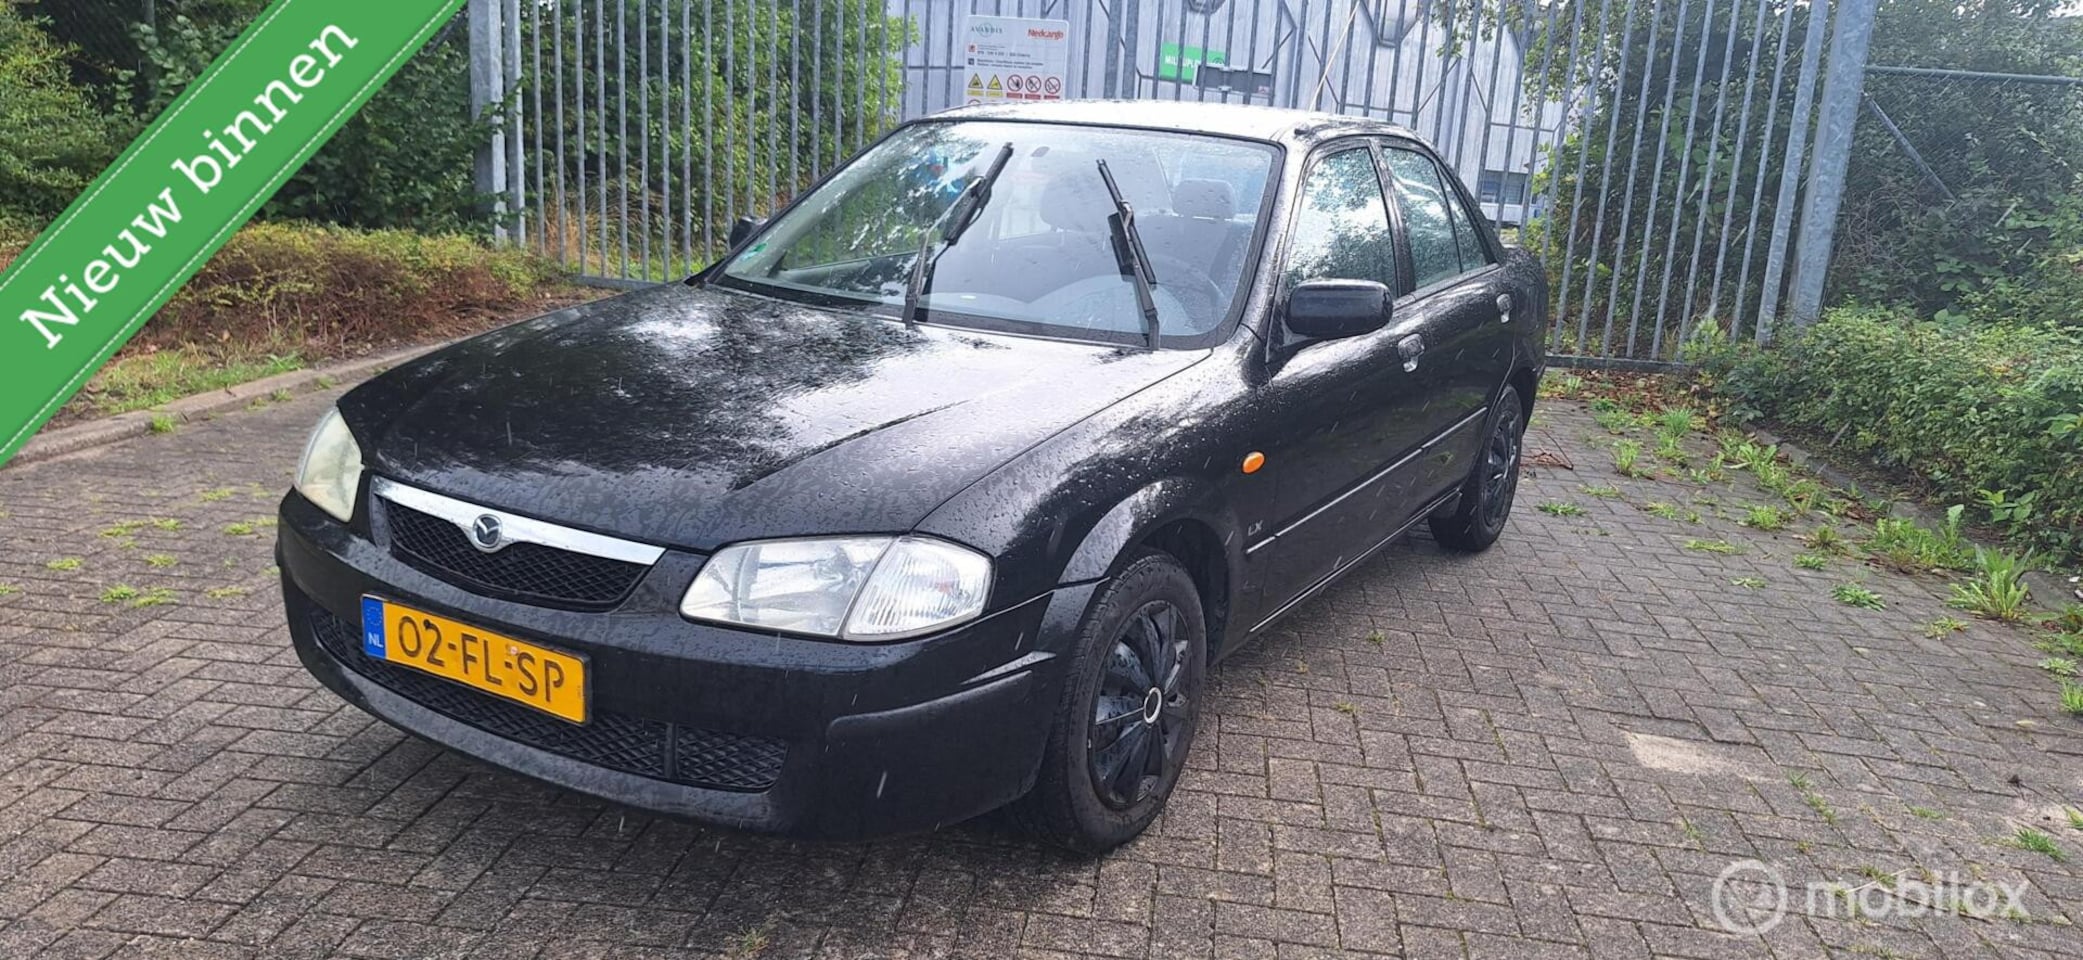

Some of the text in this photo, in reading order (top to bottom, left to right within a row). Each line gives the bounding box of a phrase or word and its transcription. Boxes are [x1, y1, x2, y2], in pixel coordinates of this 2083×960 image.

[1028, 28, 1064, 40] Nedcargo
[1248, 520, 1263, 536] LX
[367, 632, 384, 648] NL
[398, 616, 565, 703] 02-FL-SP
